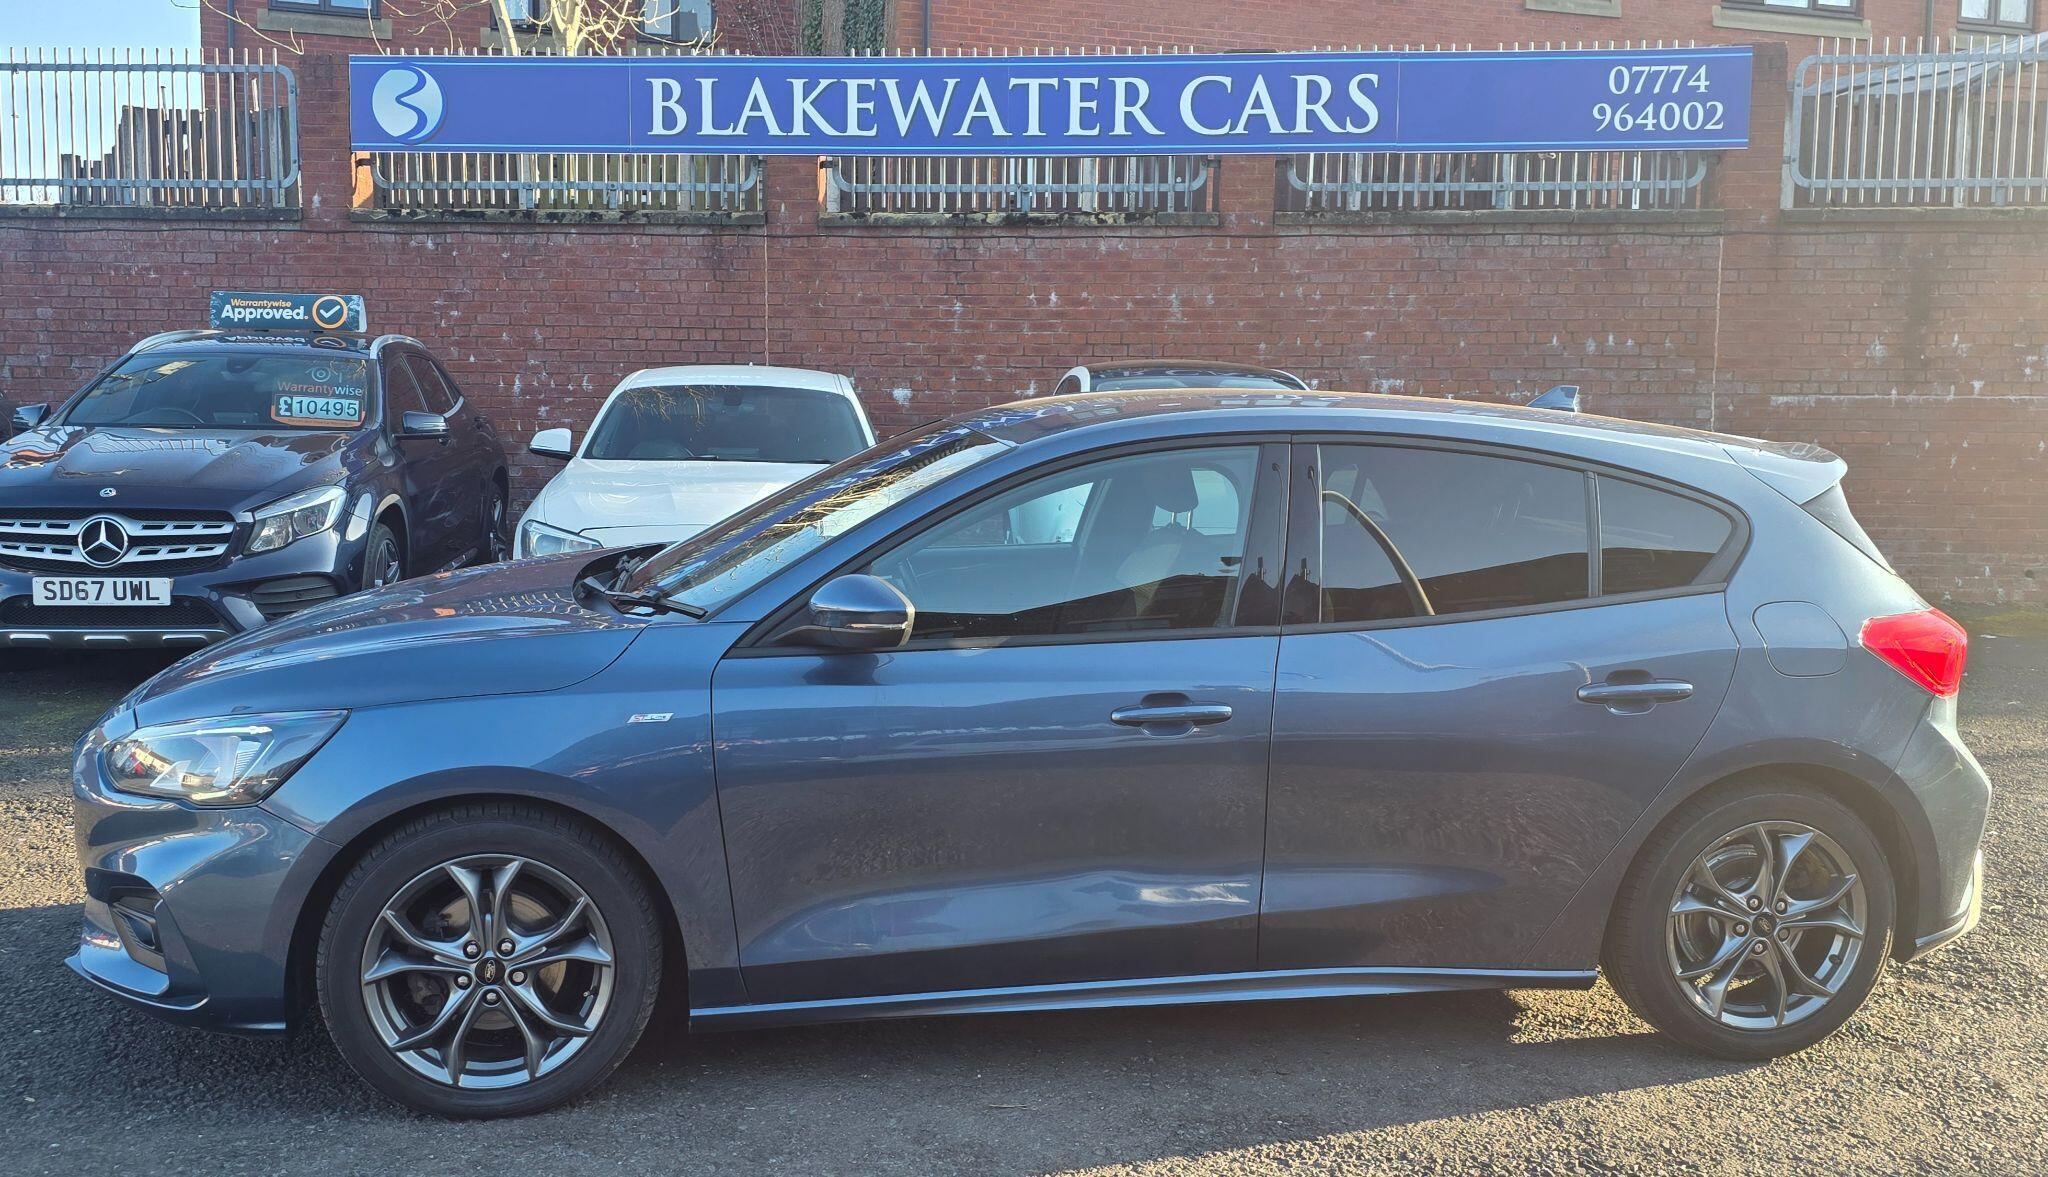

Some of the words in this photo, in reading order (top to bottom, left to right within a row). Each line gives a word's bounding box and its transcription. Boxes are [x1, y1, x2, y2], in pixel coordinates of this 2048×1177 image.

[1608, 65, 1710, 95] 07774
[646, 77, 1166, 137] BLAKEWATER
[1179, 74, 1379, 136] CARS
[1592, 101, 1725, 132] 964002
[230, 298, 292, 308] Warrantywise
[221, 305, 309, 322] Approved.
[277, 381, 362, 396] Warrantywise
[278, 397, 358, 417] £10495
[43, 580, 105, 601] SD67
[112, 580, 160, 601] UWL
